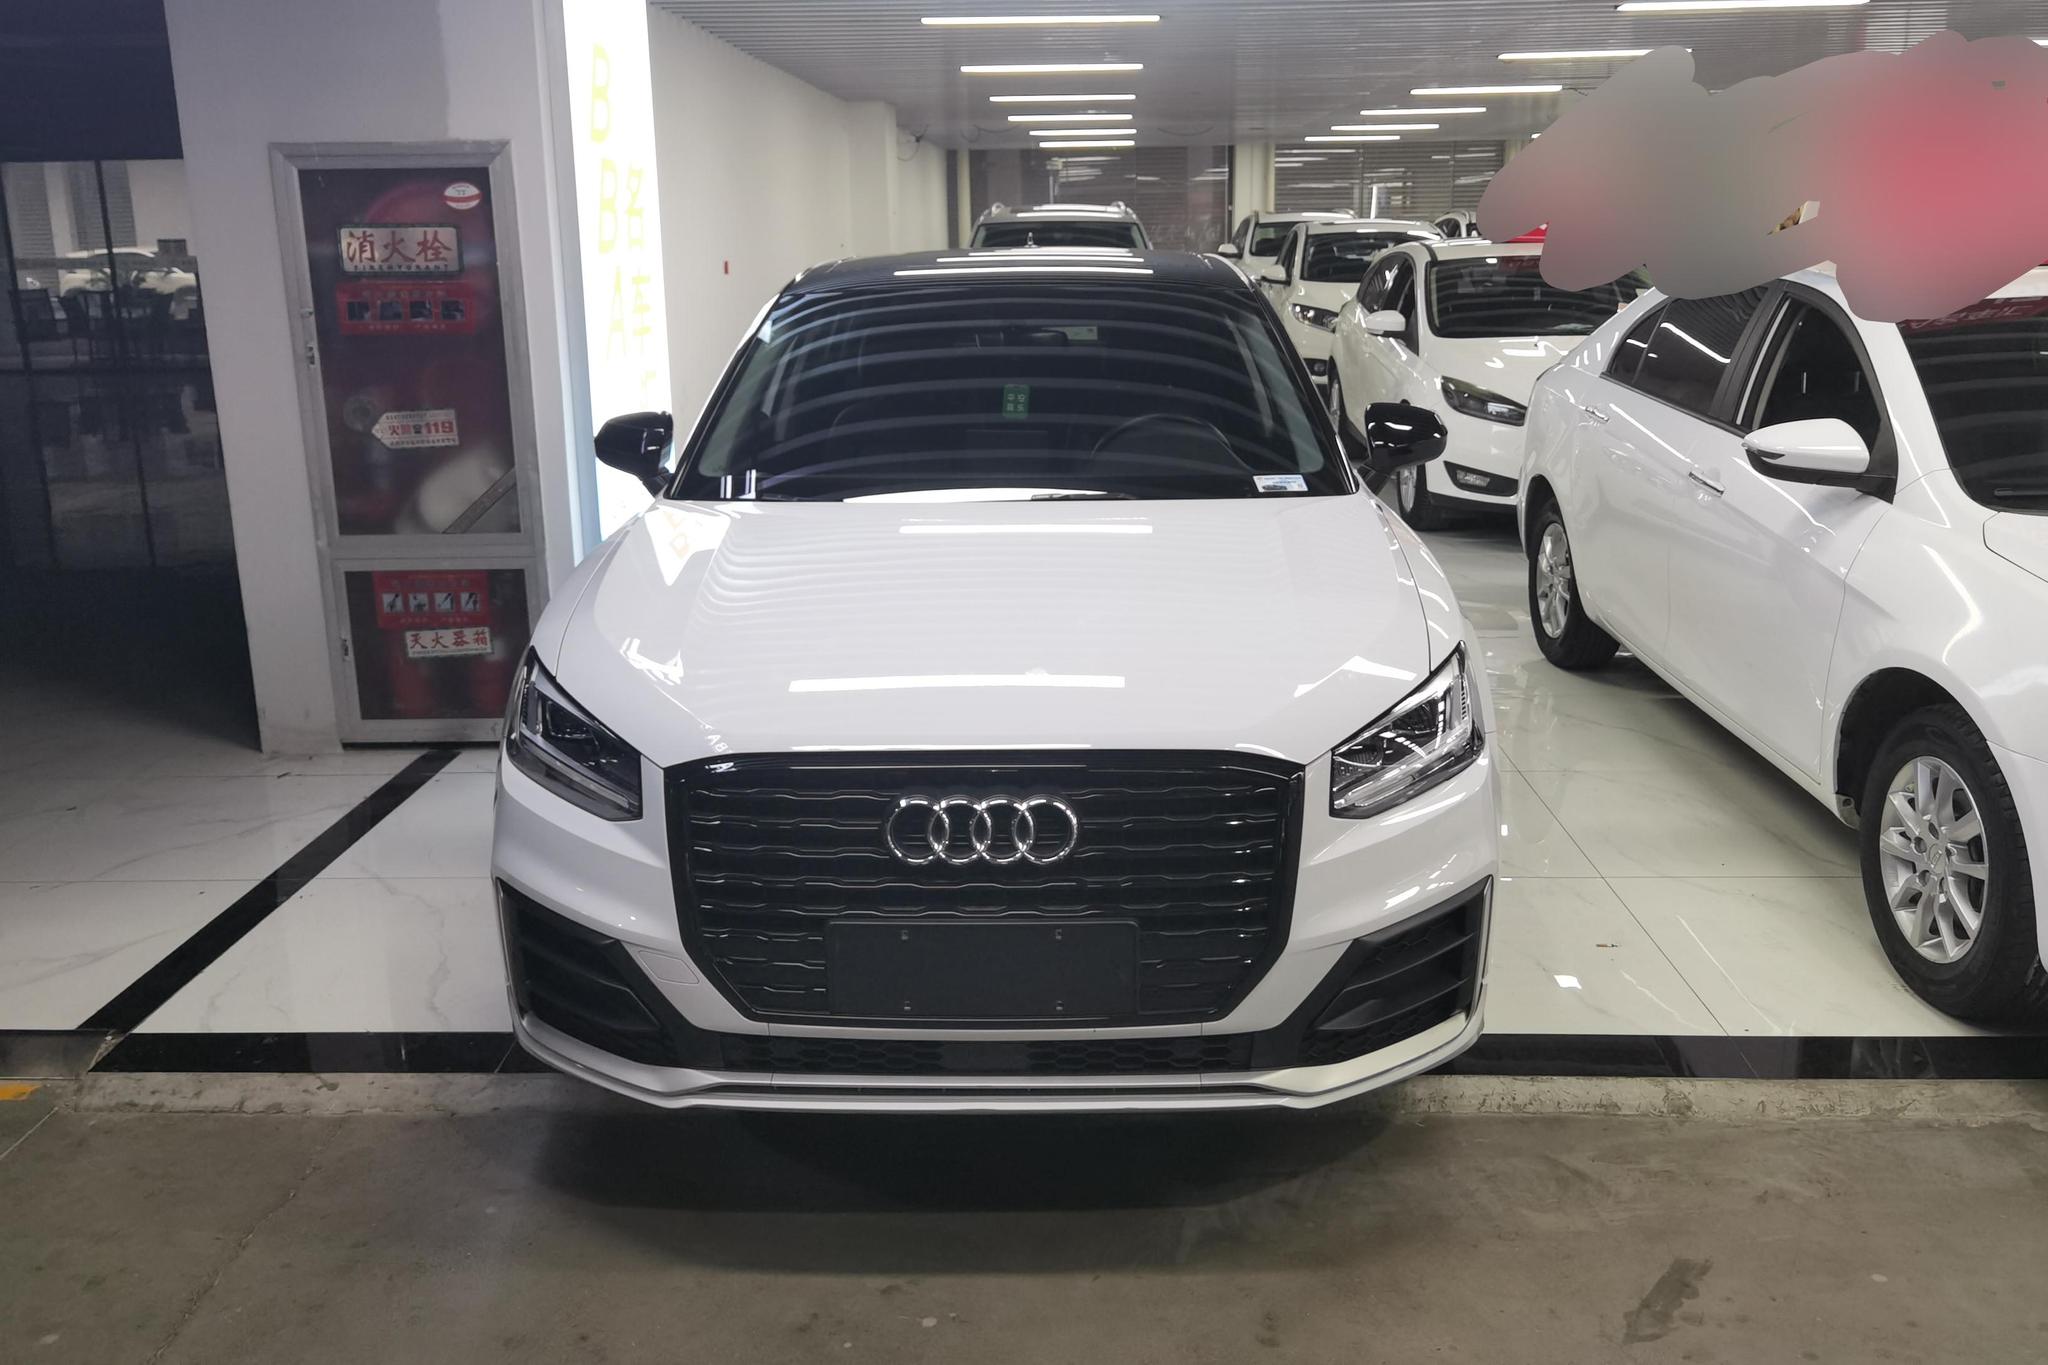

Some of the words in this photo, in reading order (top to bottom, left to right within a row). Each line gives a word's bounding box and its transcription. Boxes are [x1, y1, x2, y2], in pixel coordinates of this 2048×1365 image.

[346, 229, 453, 263] 消火栓
[424, 421, 454, 434] 119
[410, 630, 489, 649] 灭火器箱
